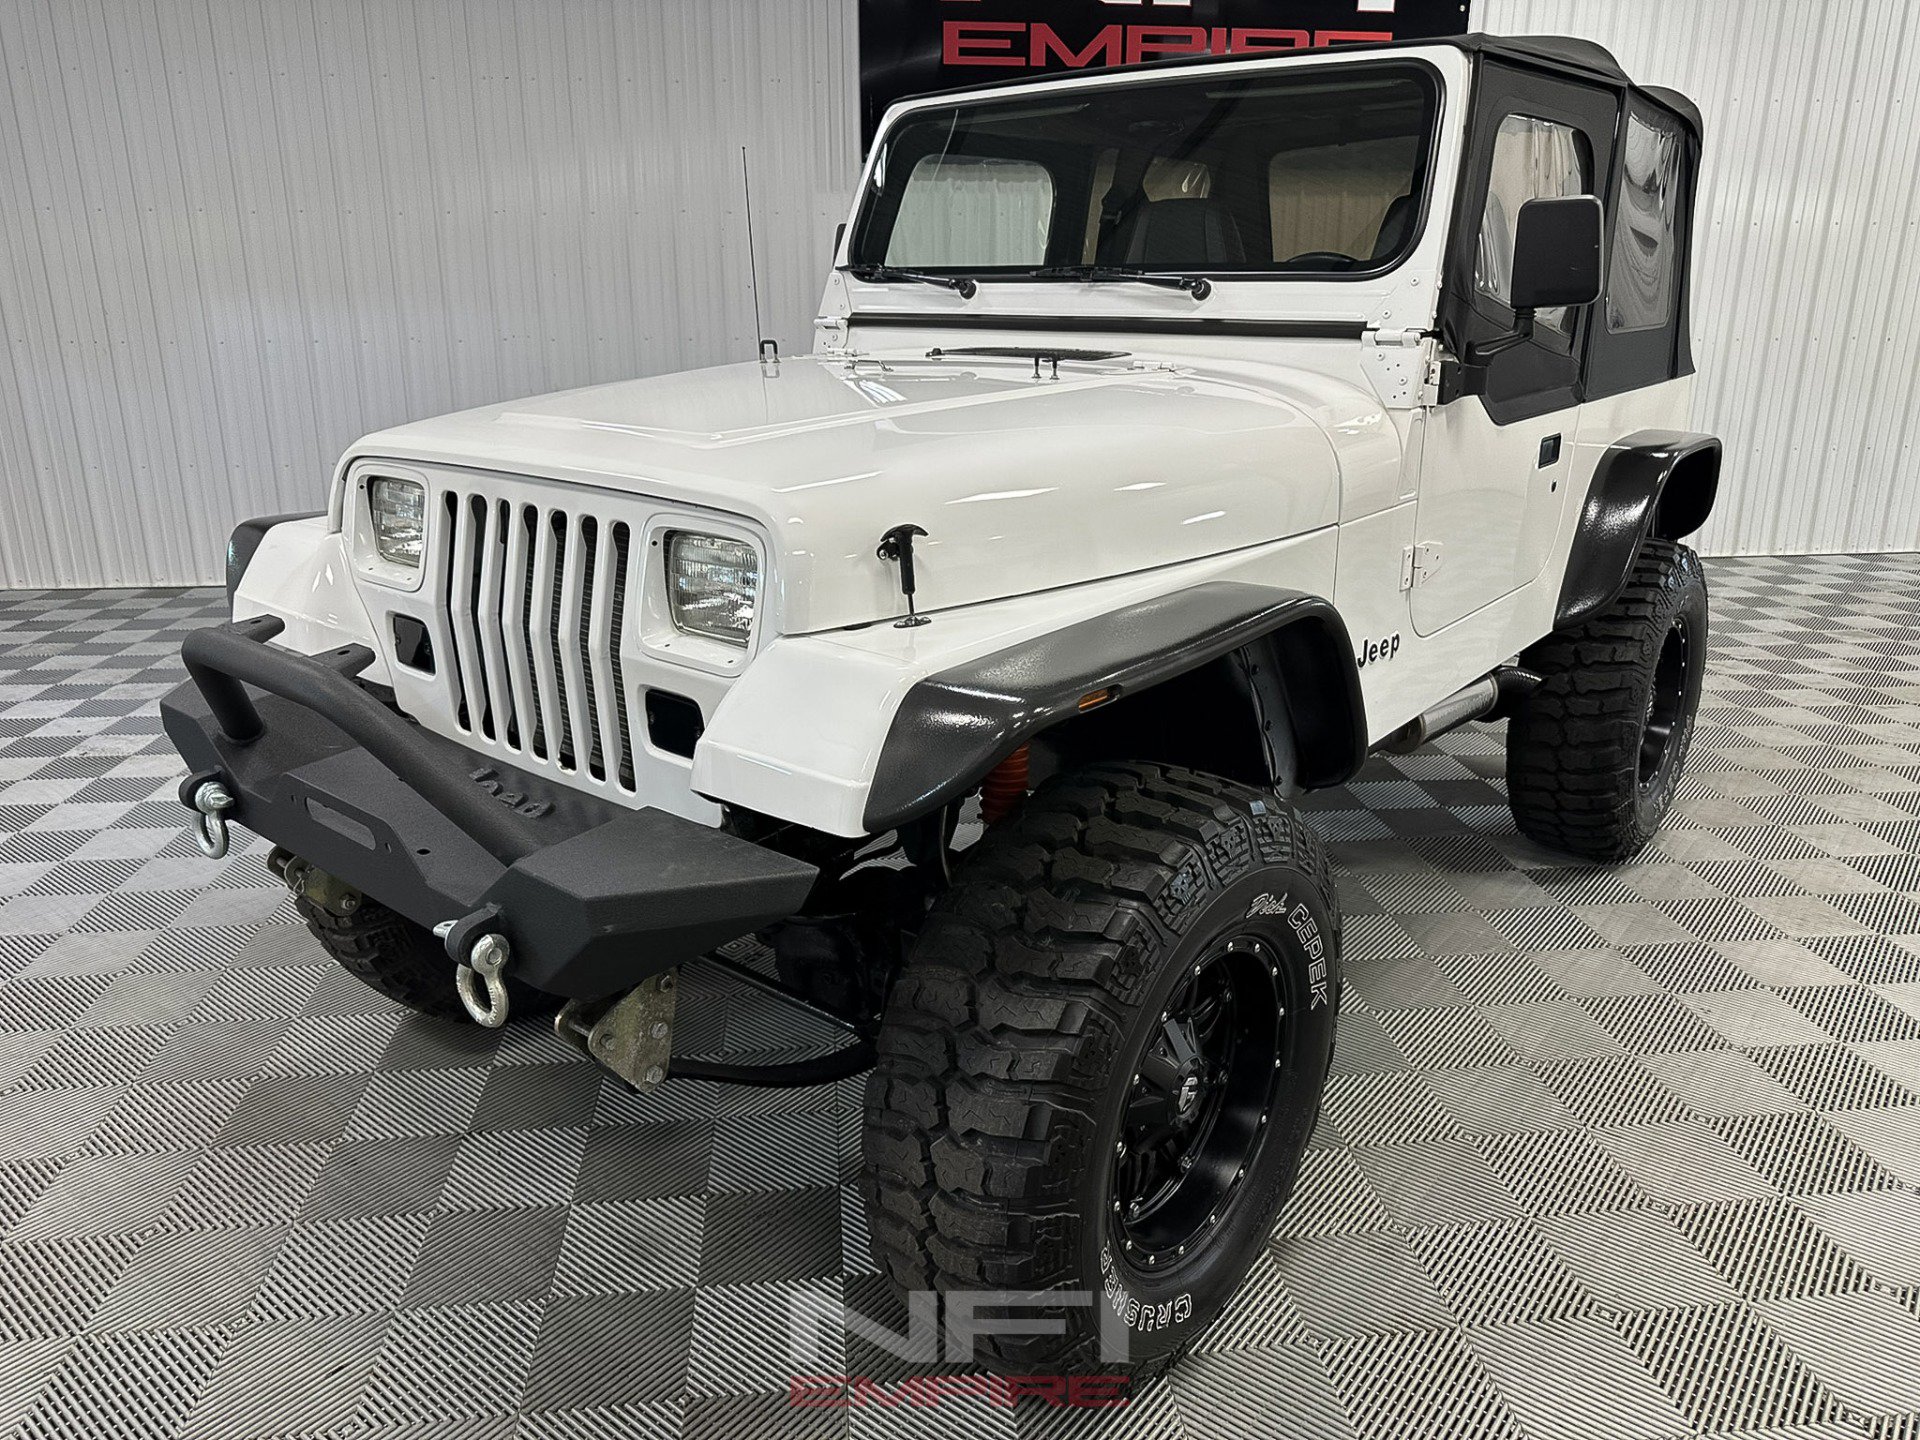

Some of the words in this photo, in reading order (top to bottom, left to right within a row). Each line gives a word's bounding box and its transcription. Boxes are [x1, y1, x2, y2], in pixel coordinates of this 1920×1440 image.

[943, 21, 1393, 67] EMPIR
[1357, 633, 1400, 668] Jeep
[1287, 903, 1328, 1011] CEPEK
[1100, 1240, 1192, 1332] CRUSHER
